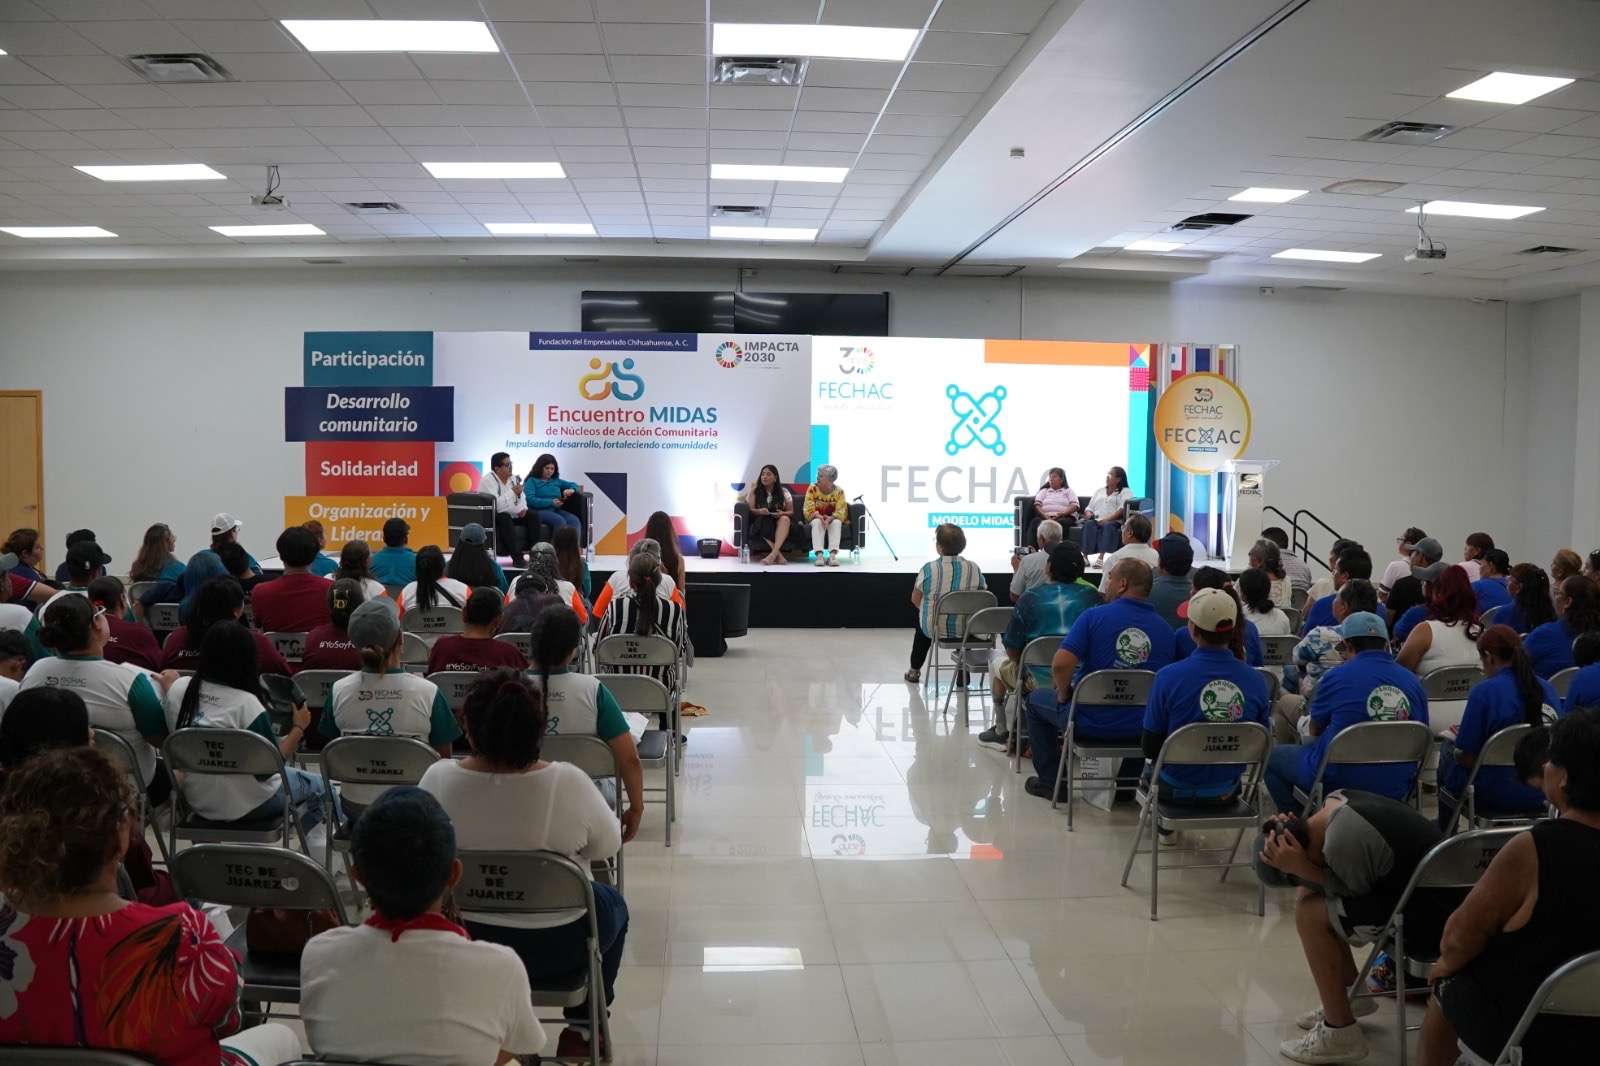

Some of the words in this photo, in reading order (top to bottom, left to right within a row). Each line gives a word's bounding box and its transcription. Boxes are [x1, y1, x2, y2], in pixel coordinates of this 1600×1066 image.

[538, 338, 571, 346] Fundación
[572, 338, 582, 346] del
[583, 339, 627, 347] Empresariado
[744, 341, 800, 352] IMPACTA
[311, 351, 425, 369] Participación
[744, 353, 776, 363] 2030
[819, 382, 893, 399] FECHAC
[326, 393, 411, 409] Desarrollo
[548, 405, 645, 423] Encuentro
[650, 406, 718, 423] MIDAS
[1184, 404, 1224, 415] FECHAC
[319, 416, 418, 432] comunitario
[545, 427, 559, 437] de
[560, 425, 600, 437] Núcleos
[602, 427, 615, 437] de
[617, 426, 651, 438] Acción
[654, 427, 718, 438] Comunitaria
[505, 440, 555, 450] Impulsando
[557, 440, 601, 451] desarrollo,
[602, 440, 660, 451] fortaleciendo
[661, 440, 719, 451] comunidades
[320, 460, 418, 476] Solidaridad
[309, 503, 417, 522] Organización
[420, 506, 431, 522] y
[932, 515, 980, 527] MODELO
[331, 526, 384, 542] Lidera
[1113, 679, 1129, 687] TEC
[203, 740, 225, 750] TEC
[1207, 735, 1225, 743] TEC
[1202, 744, 1240, 752] JUAREZ
[198, 759, 239, 768] JUAREZ
[225, 864, 254, 875] TEC
[257, 867, 279, 877] DE
[479, 864, 509, 875] TEC
[225, 877, 281, 889] JUAREZ
[485, 878, 504, 888] DE
[466, 889, 525, 901] JUAREZ
